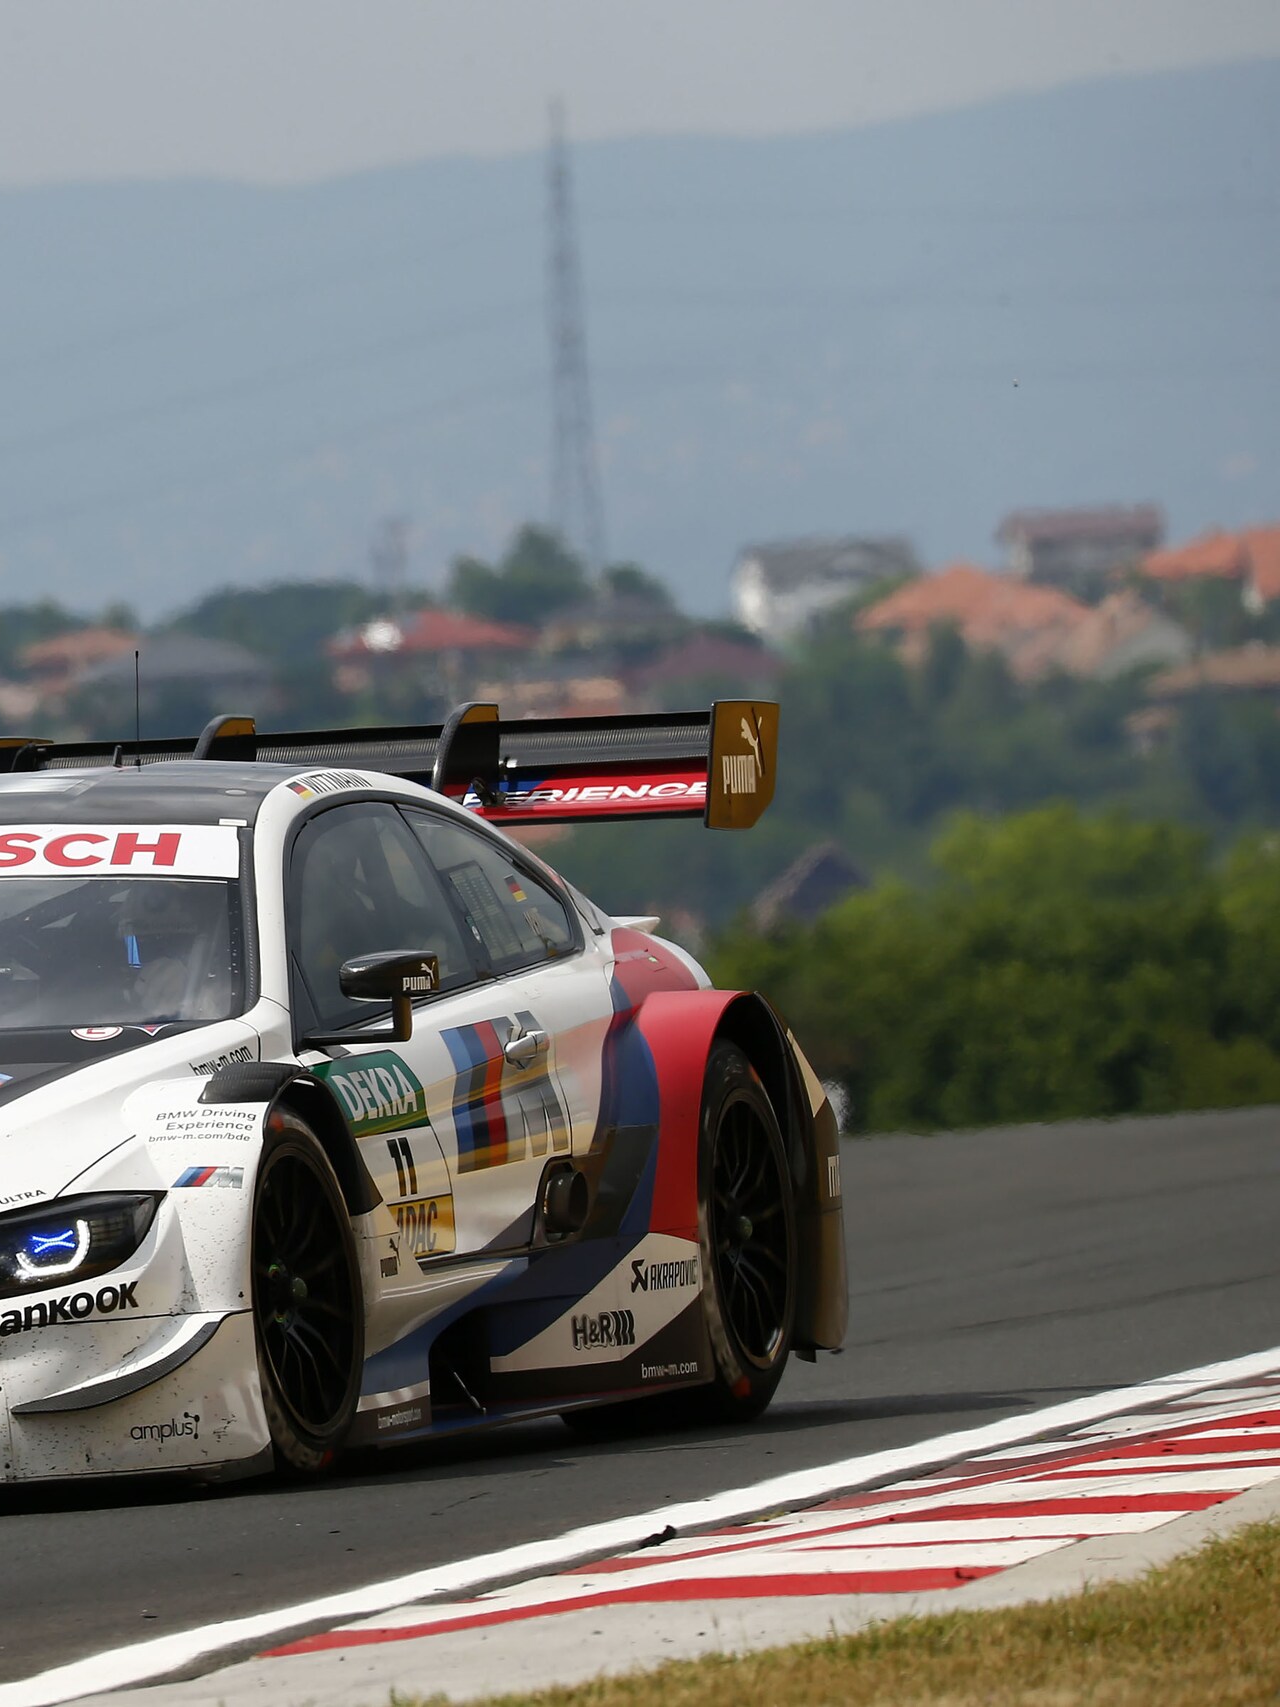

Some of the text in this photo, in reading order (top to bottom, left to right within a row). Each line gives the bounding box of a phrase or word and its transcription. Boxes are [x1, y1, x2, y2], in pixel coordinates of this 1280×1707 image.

[721, 754, 756, 794] PUMA
[402, 975, 431, 992] PUMA
[331, 1064, 418, 1122] DEKRA
[156, 1109, 257, 1122] BMW Driving
[166, 1121, 253, 1132] Experience
[148, 1132, 251, 1143] bmw-m.com/bde
[386, 1137, 418, 1197] 11
[641, 1361, 698, 1379] bmw-m.com
[130, 1417, 195, 1443] amplus
